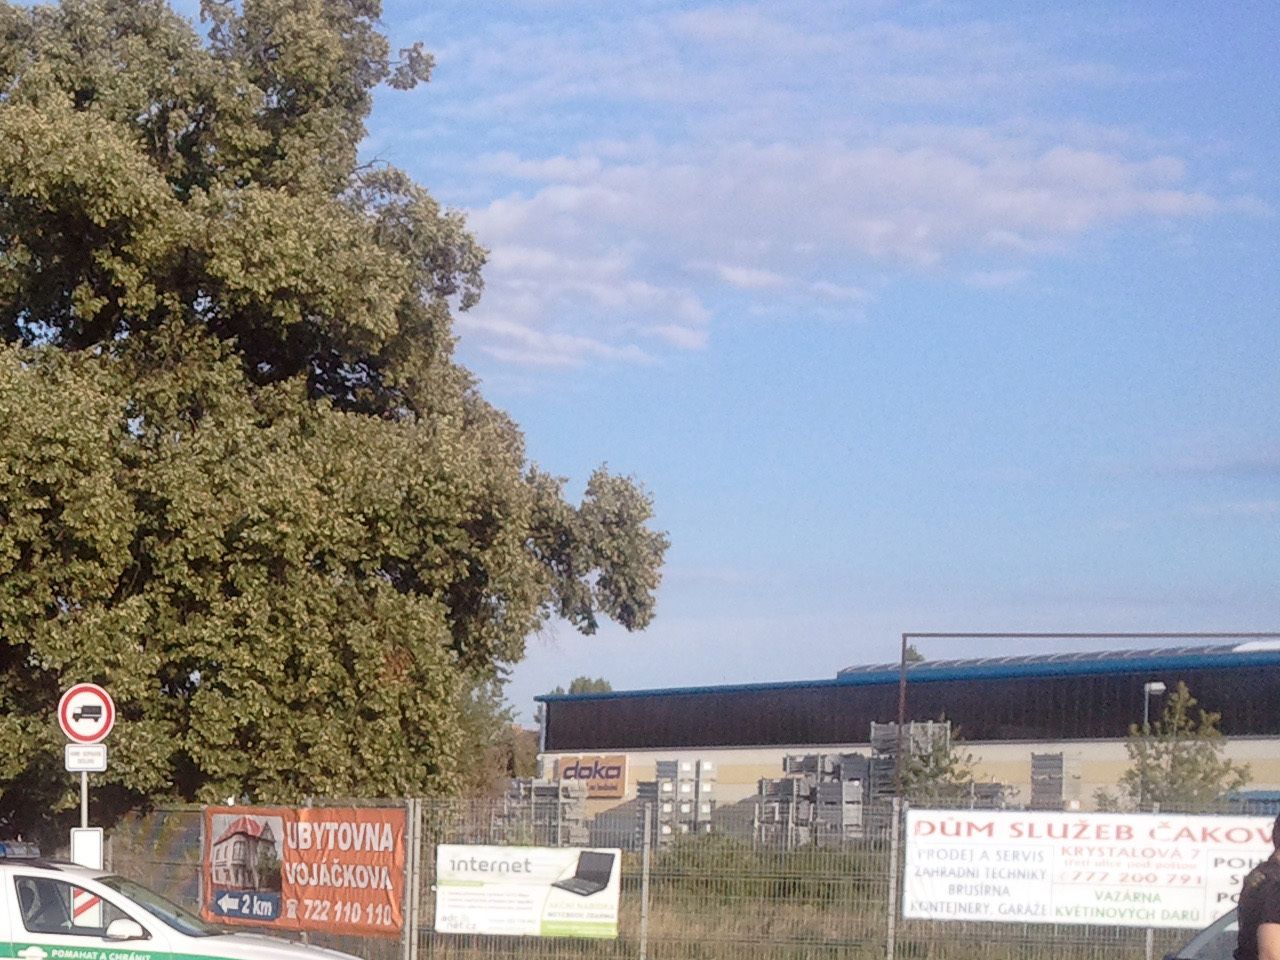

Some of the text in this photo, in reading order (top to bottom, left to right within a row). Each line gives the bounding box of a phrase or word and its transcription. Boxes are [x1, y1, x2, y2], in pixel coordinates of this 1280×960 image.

[563, 760, 621, 779] doka
[287, 821, 394, 852] UBYTOVNA
[914, 816, 1274, 844] DŮM SLUŽEB ČAKOV
[917, 848, 1045, 862] PRODEJ A SERVIS
[1190, 849, 1200, 859] 7
[286, 857, 393, 890] VOJÁČKOVA
[450, 857, 532, 874] internet
[985, 867, 1047, 880] TECHNIKY
[1072, 871, 1110, 882] 777
[1119, 873, 1158, 883] 200
[948, 882, 1011, 897] BRUSÍRNA
[1094, 889, 1162, 903] VAZÁRNA
[241, 894, 273, 916] 2 km
[303, 898, 392, 926] 722 110 110
[998, 900, 1047, 916] GARÁŽE
[99, 951, 108, 960] A
